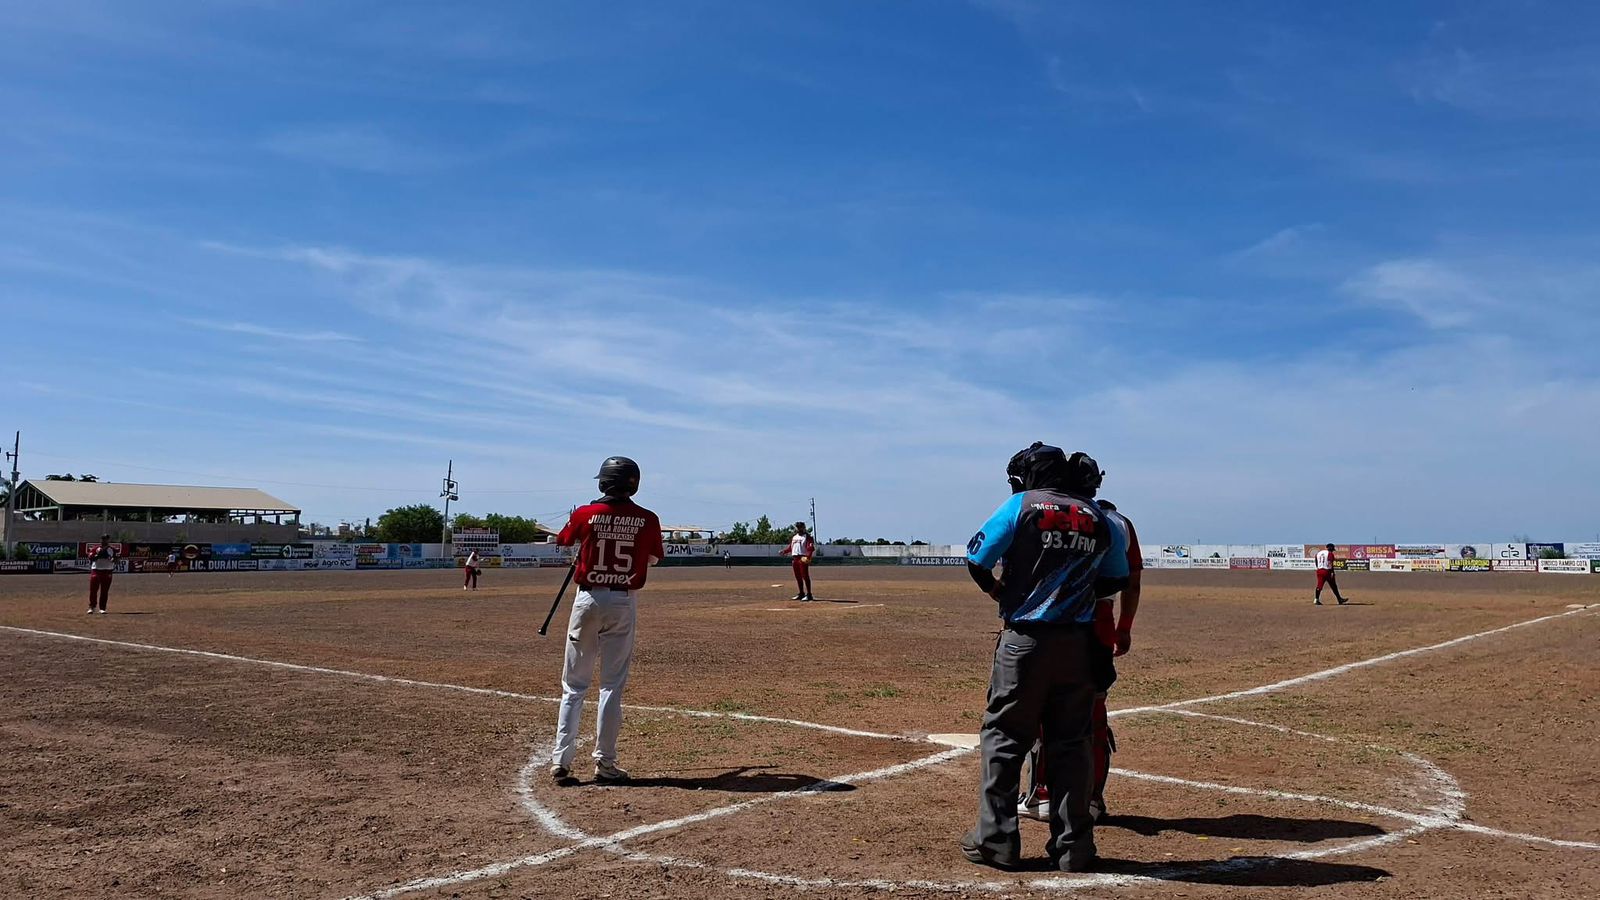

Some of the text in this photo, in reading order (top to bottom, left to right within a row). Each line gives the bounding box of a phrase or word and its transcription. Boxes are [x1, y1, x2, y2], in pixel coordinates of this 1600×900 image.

[588, 514, 646, 528] JUAN CARLOS
[593, 524, 639, 535] VILLA ROMERO
[1366, 546, 1393, 554] BRISSA
[593, 539, 634, 573] 15
[189, 560, 207, 570] LIC.
[321, 559, 340, 568] Agro
[340, 558, 352, 567] RC
[911, 557, 966, 566] TALLER MOZA
[586, 571, 637, 585] Comex
